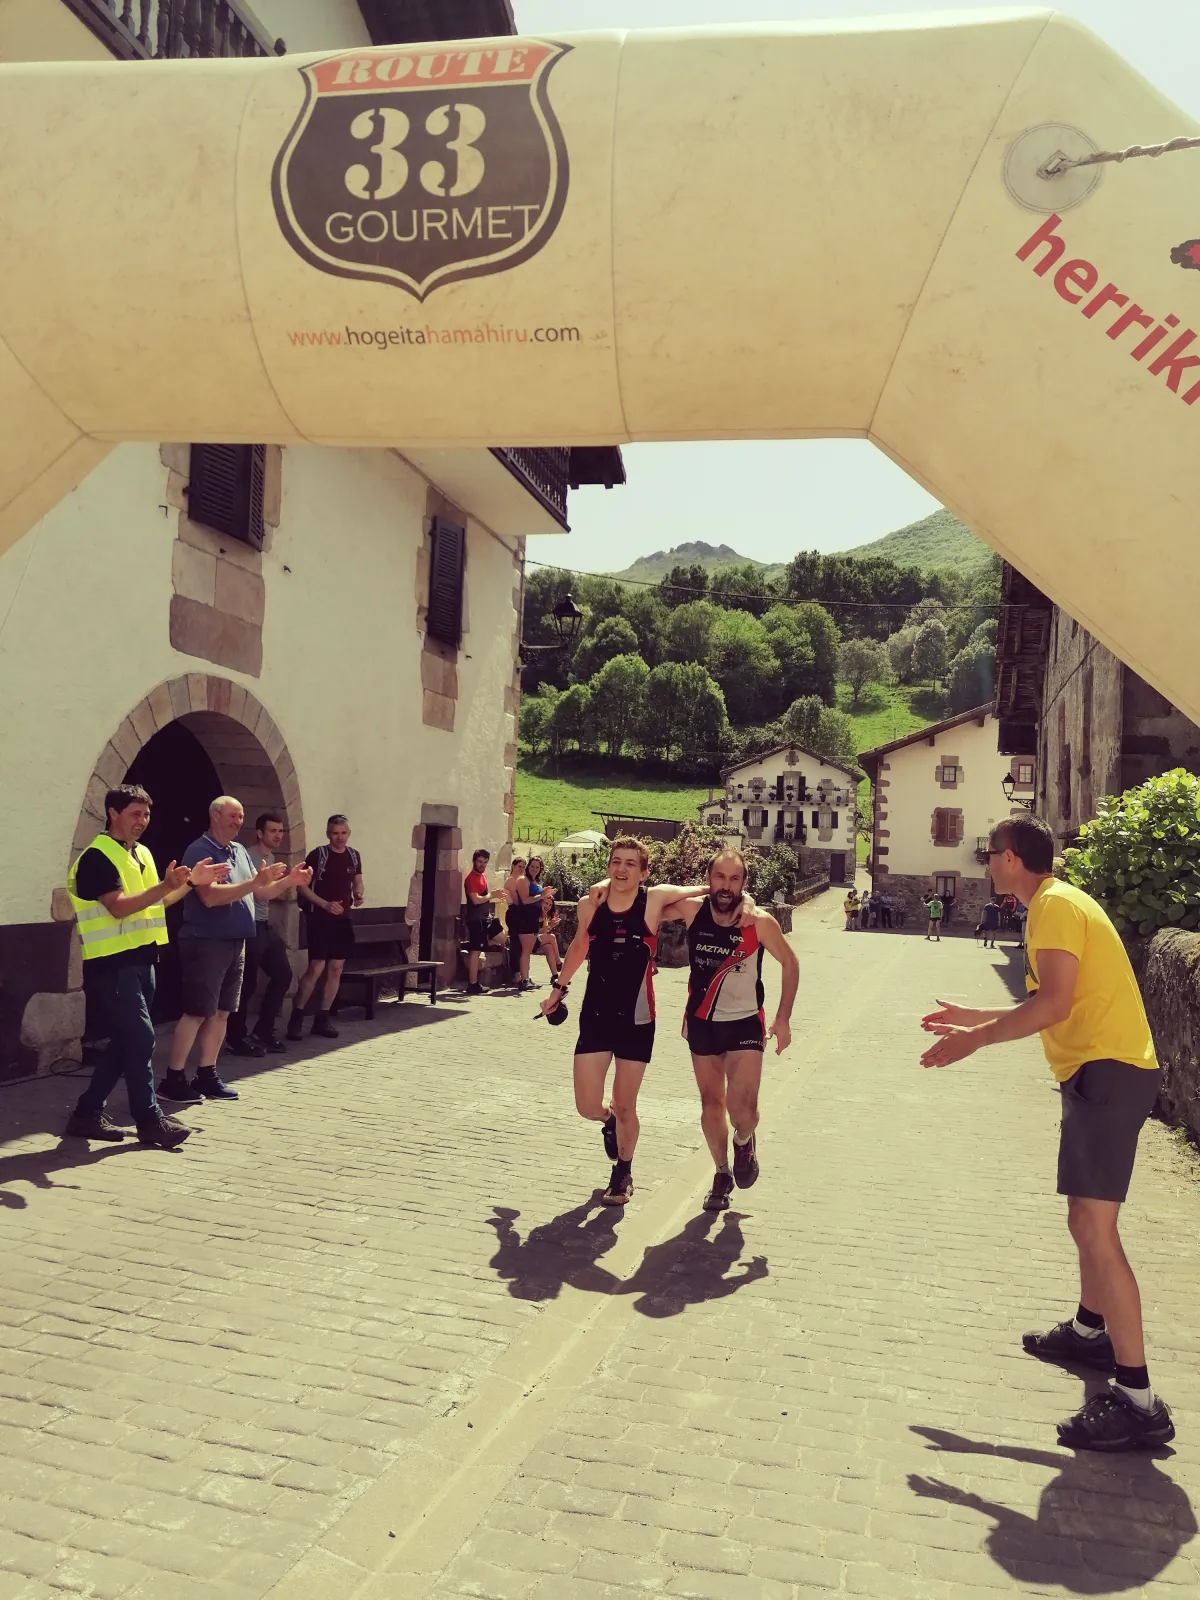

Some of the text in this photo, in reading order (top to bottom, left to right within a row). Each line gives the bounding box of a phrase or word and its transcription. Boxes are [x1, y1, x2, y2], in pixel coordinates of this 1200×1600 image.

[332, 47, 529, 86] ROUTE
[344, 103, 486, 200] 33
[325, 204, 540, 244] GOURMET
[287, 323, 581, 351] www.hogeitahamahiru.com
[695, 943, 730, 955] BAZTAN
